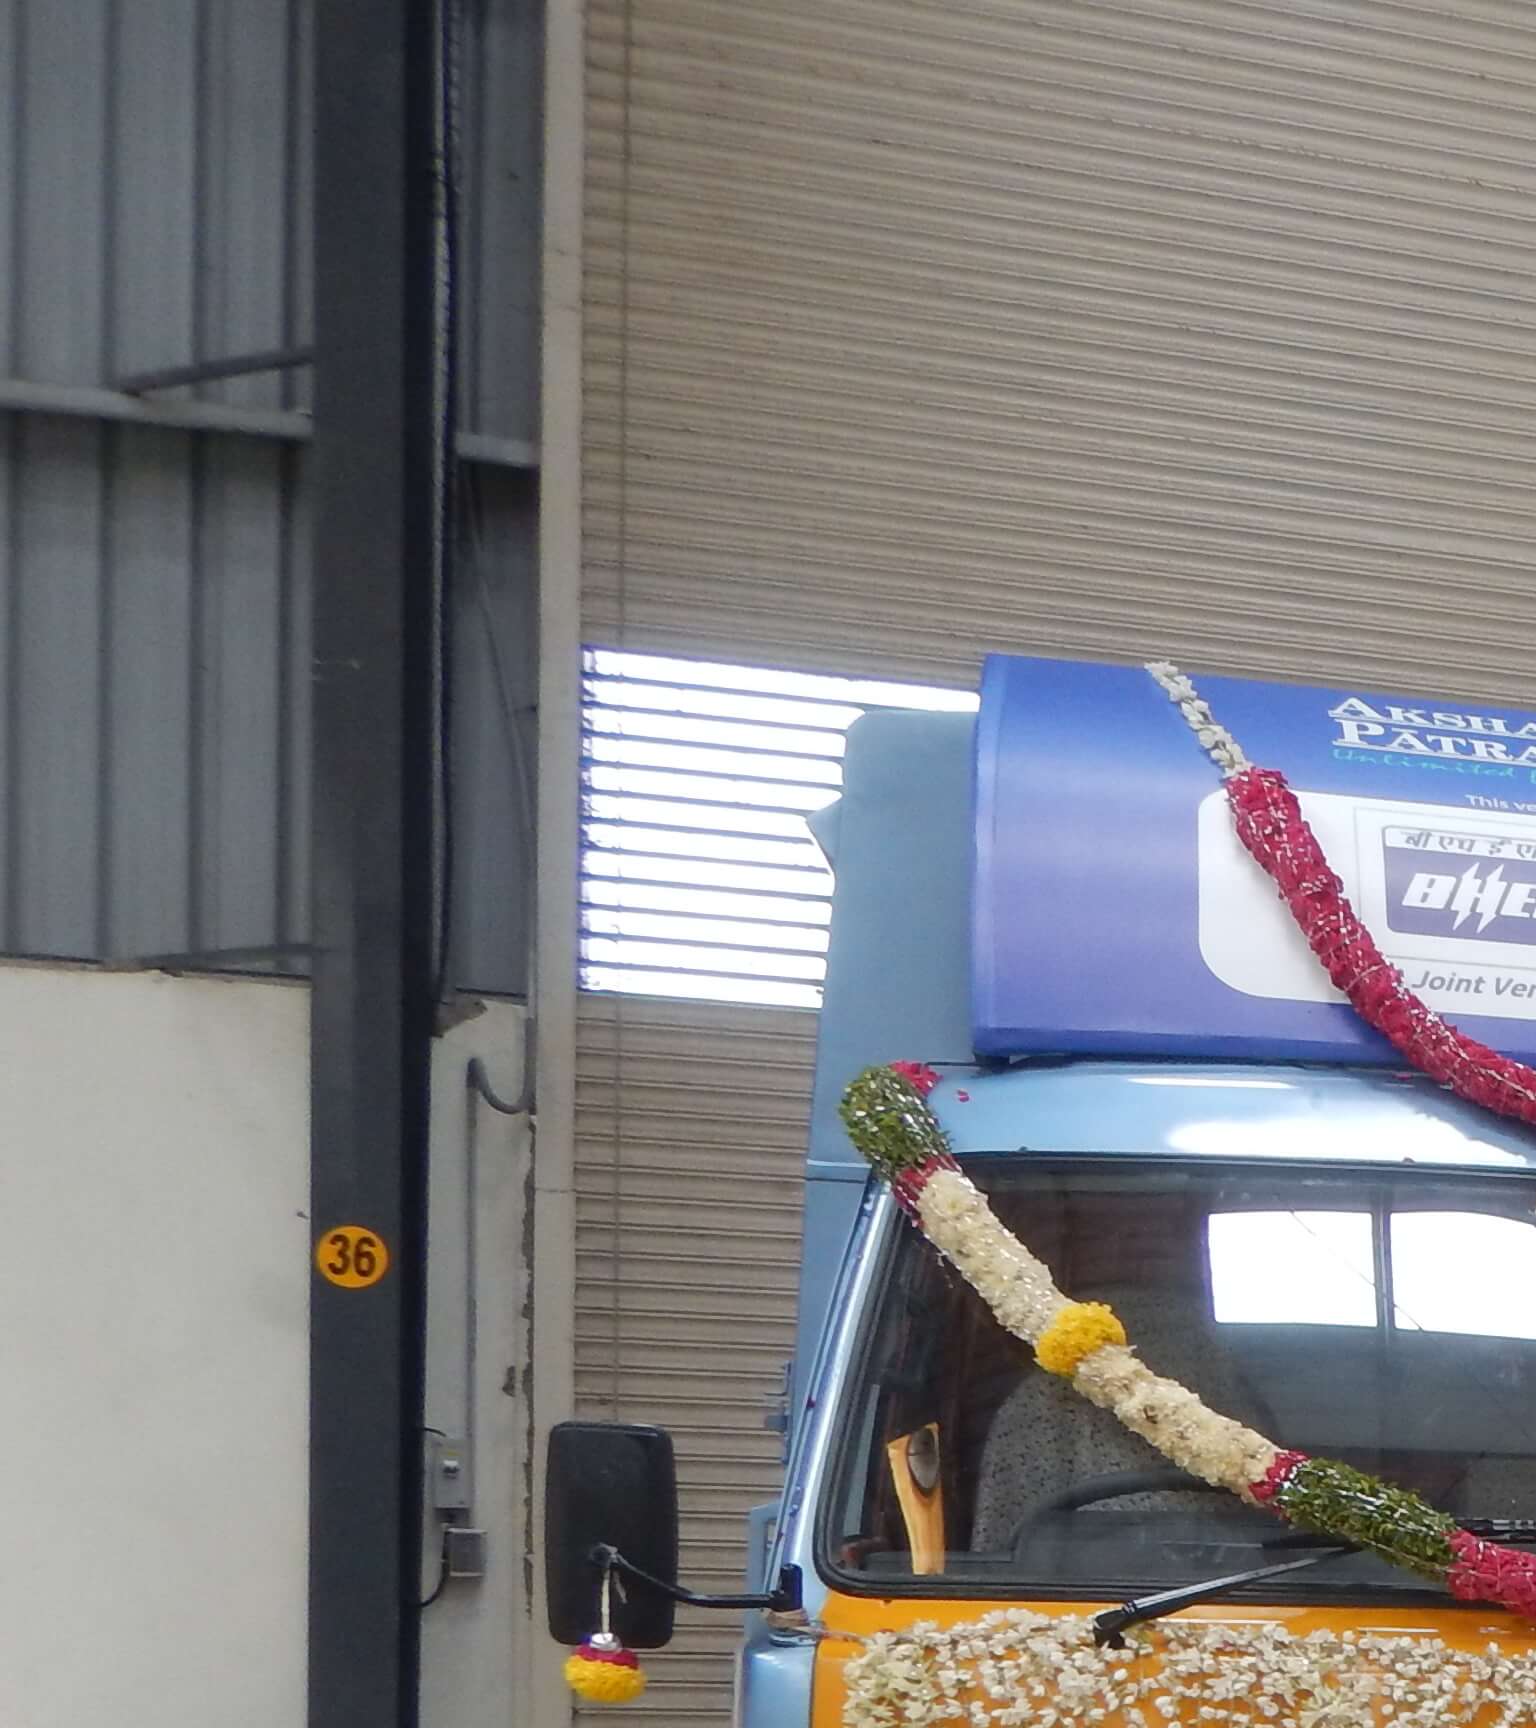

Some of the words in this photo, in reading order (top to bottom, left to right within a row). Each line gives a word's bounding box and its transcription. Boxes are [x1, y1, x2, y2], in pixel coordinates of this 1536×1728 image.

[1332, 749, 1516, 778] Unlimited
[1464, 793, 1509, 810] This
[1411, 970, 1486, 995] Joint
[328, 1234, 377, 1278] 36
